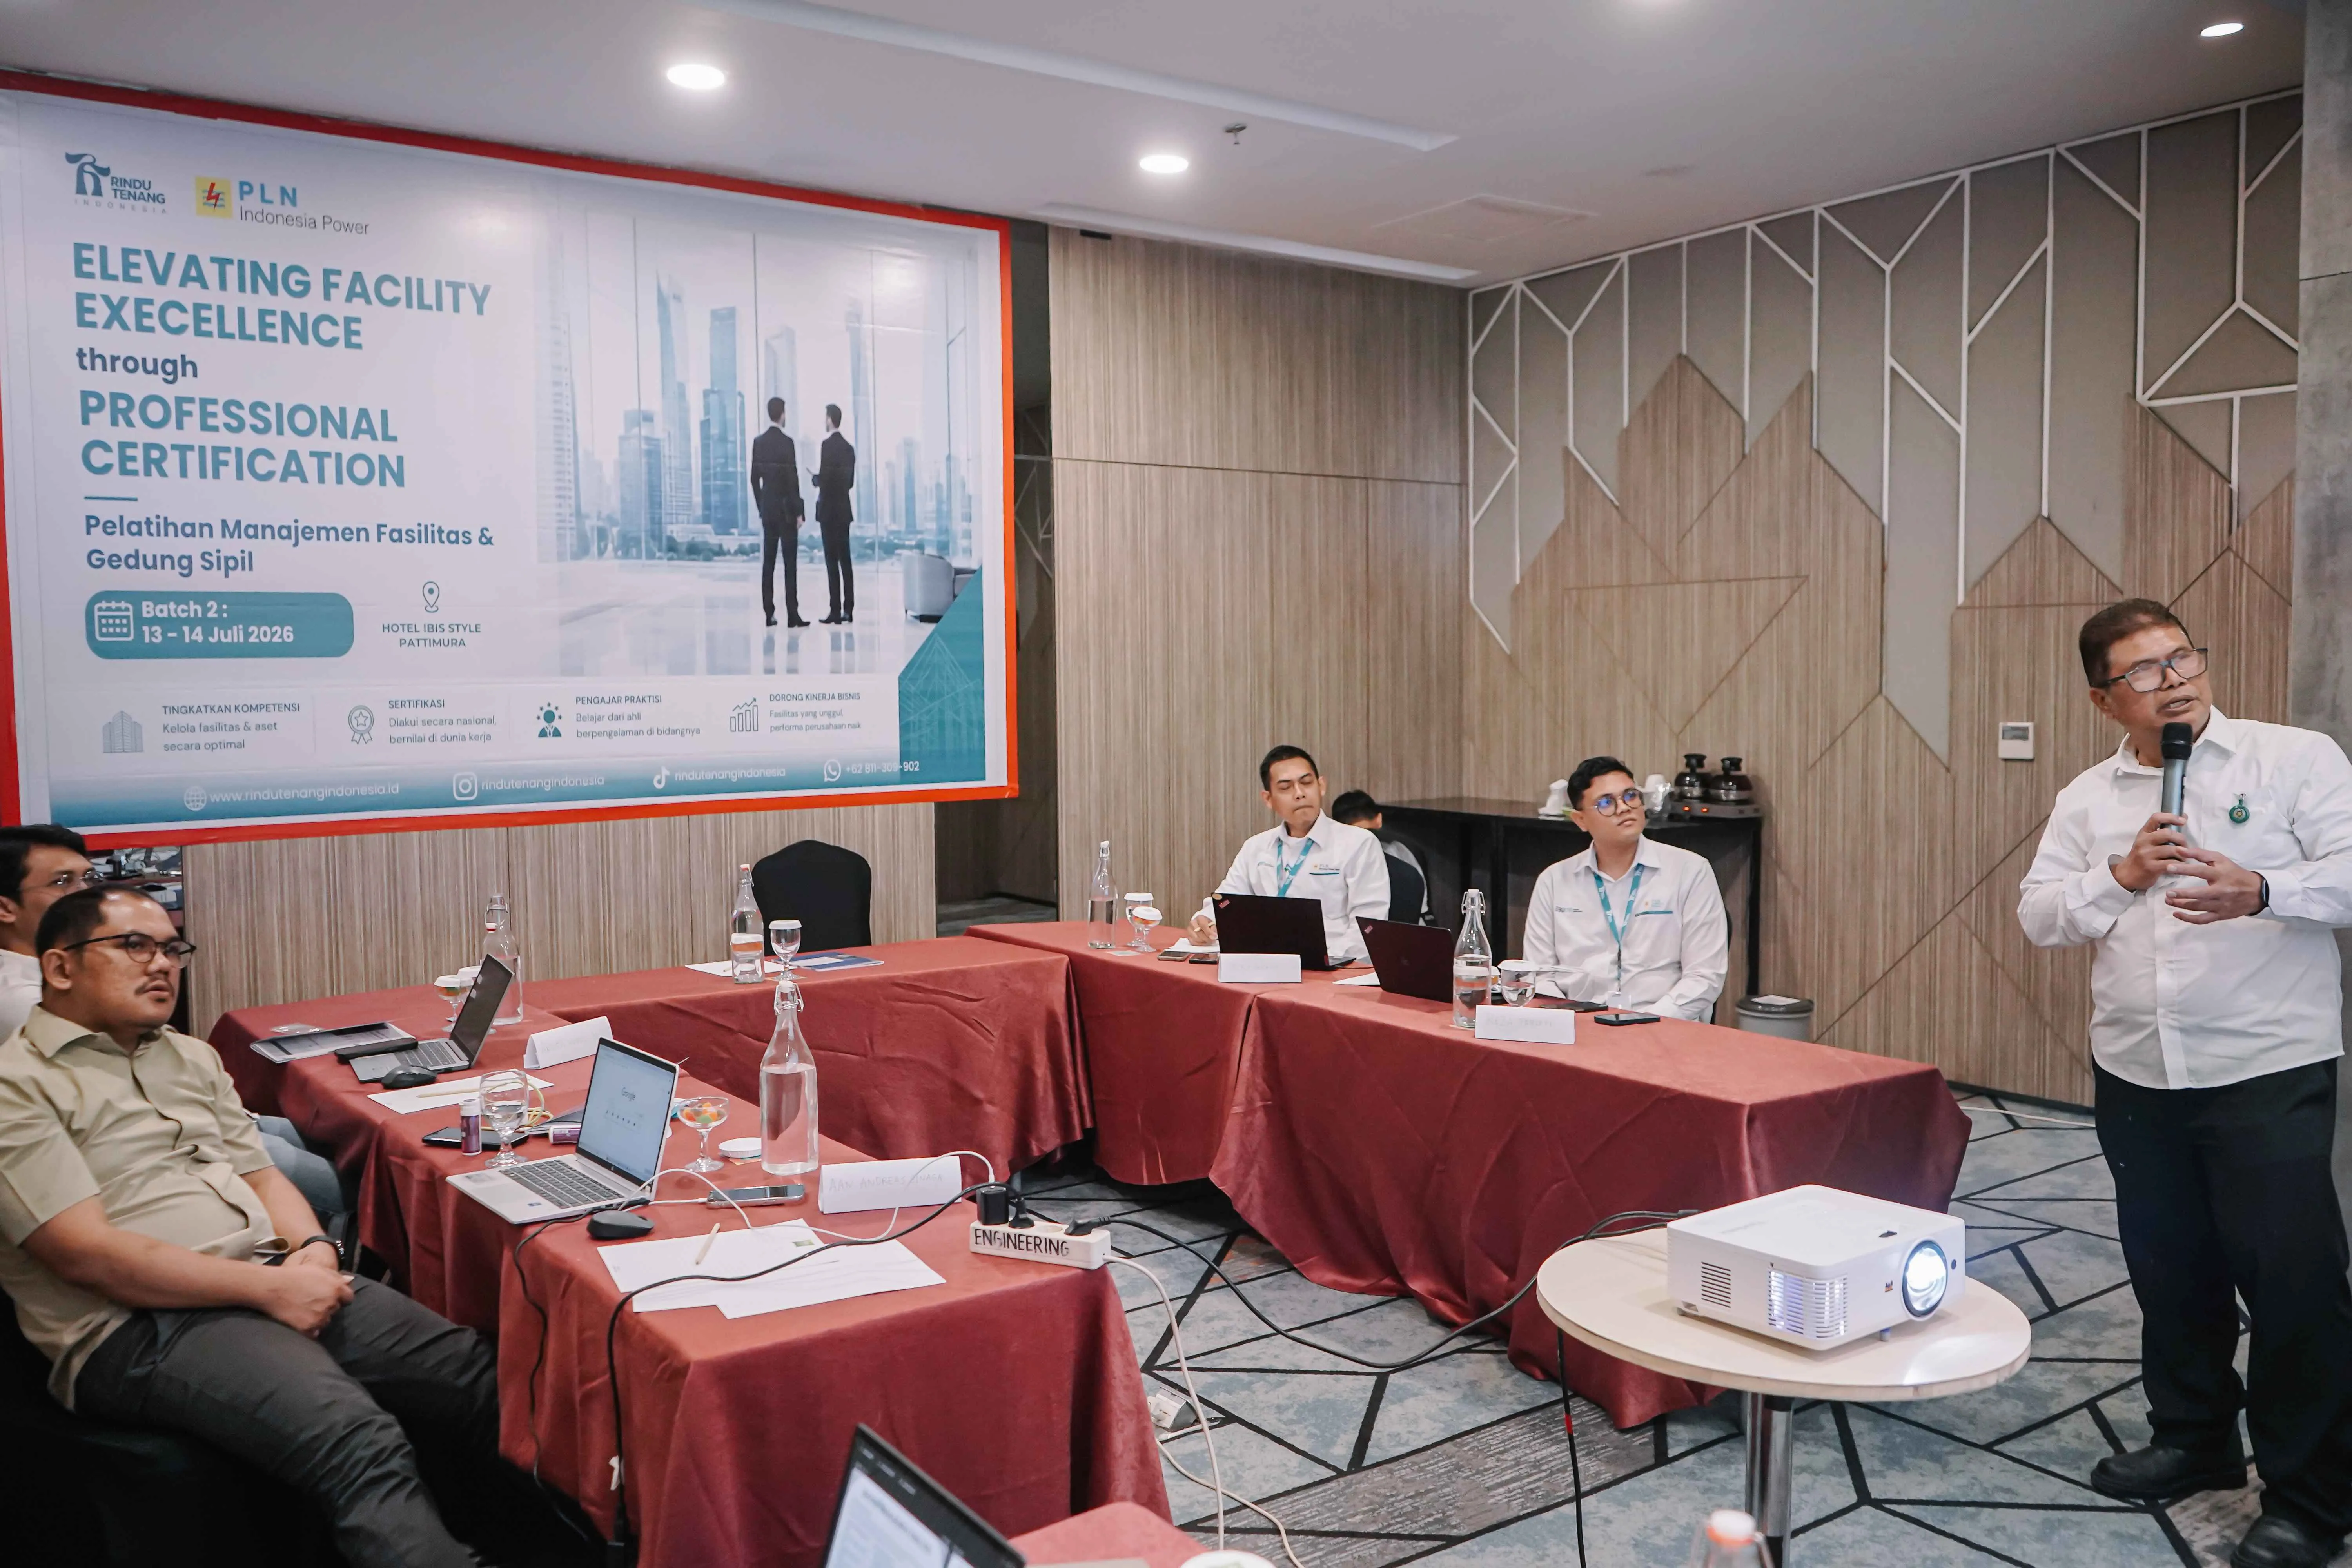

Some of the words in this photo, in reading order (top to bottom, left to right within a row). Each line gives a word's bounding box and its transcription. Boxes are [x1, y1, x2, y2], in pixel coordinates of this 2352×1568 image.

[110, 176, 152, 191] RINDU
[111, 188, 166, 205] TENANG
[239, 181, 298, 208] PLN
[74, 198, 168, 214] INDONESIA
[240, 205, 317, 230] Indonesia
[322, 215, 370, 235] Power
[73, 242, 312, 299] ELEVATING
[322, 267, 492, 316] FACILITY
[75, 291, 363, 350] EXECELLENCE
[76, 347, 198, 384] through
[80, 390, 398, 443] PROFESSIONAL
[81, 439, 405, 488] CERTIFICATION
[85, 514, 214, 539] Pelatihan
[220, 518, 371, 548] Manajemen
[376, 523, 472, 546] Fasilitas
[478, 527, 494, 546] &
[86, 548, 194, 577] Gedung
[200, 550, 254, 579] Sipil
[142, 600, 202, 618] Batch
[142, 625, 162, 643] 13
[182, 626, 204, 643] 14
[208, 625, 244, 643] Juli
[248, 625, 294, 643] 2026
[382, 623, 420, 633] HOTEL
[423, 623, 445, 633] IBIS
[448, 623, 481, 633] STYLE
[399, 638, 466, 647] PATTIMURA
[388, 699, 445, 709] SERTIFIKASI
[575, 696, 622, 705] PENGAJAR
[624, 695, 662, 704] PRAKTISI
[162, 705, 231, 715] TINGKATKAN
[234, 703, 300, 713] KOMPETENSI
[770, 710, 798, 718] Fasilitas
[800, 710, 817, 719] yang
[389, 717, 418, 727] Diakui
[456, 715, 496, 725] nasional,
[576, 712, 604, 724] Belajar
[608, 711, 624, 721] dari
[627, 711, 641, 721] ahli
[162, 722, 196, 733] Kelola
[199, 722, 240, 733] fasilitas
[243, 722, 252, 731] &
[254, 721, 278, 731] aset
[577, 729, 644, 739] berpengalaman
[646, 727, 655, 736] di
[657, 726, 701, 737] bidangnya
[770, 724, 803, 733] performa
[805, 723, 846, 732] perusahaan
[390, 733, 425, 744] bernilai
[428, 733, 437, 742] di
[440, 732, 466, 742] dunia
[468, 731, 492, 744] kerja
[163, 742, 201, 752] secara
[203, 739, 245, 752] optimal
[675, 767, 786, 782] rindutenangindonesia
[845, 764, 862, 774] +62
[482, 776, 604, 791] rindutenangindonesia
[210, 783, 399, 802] www.rindutenangindonesia.id
[975, 1228, 1070, 1257] ENGINEERING
